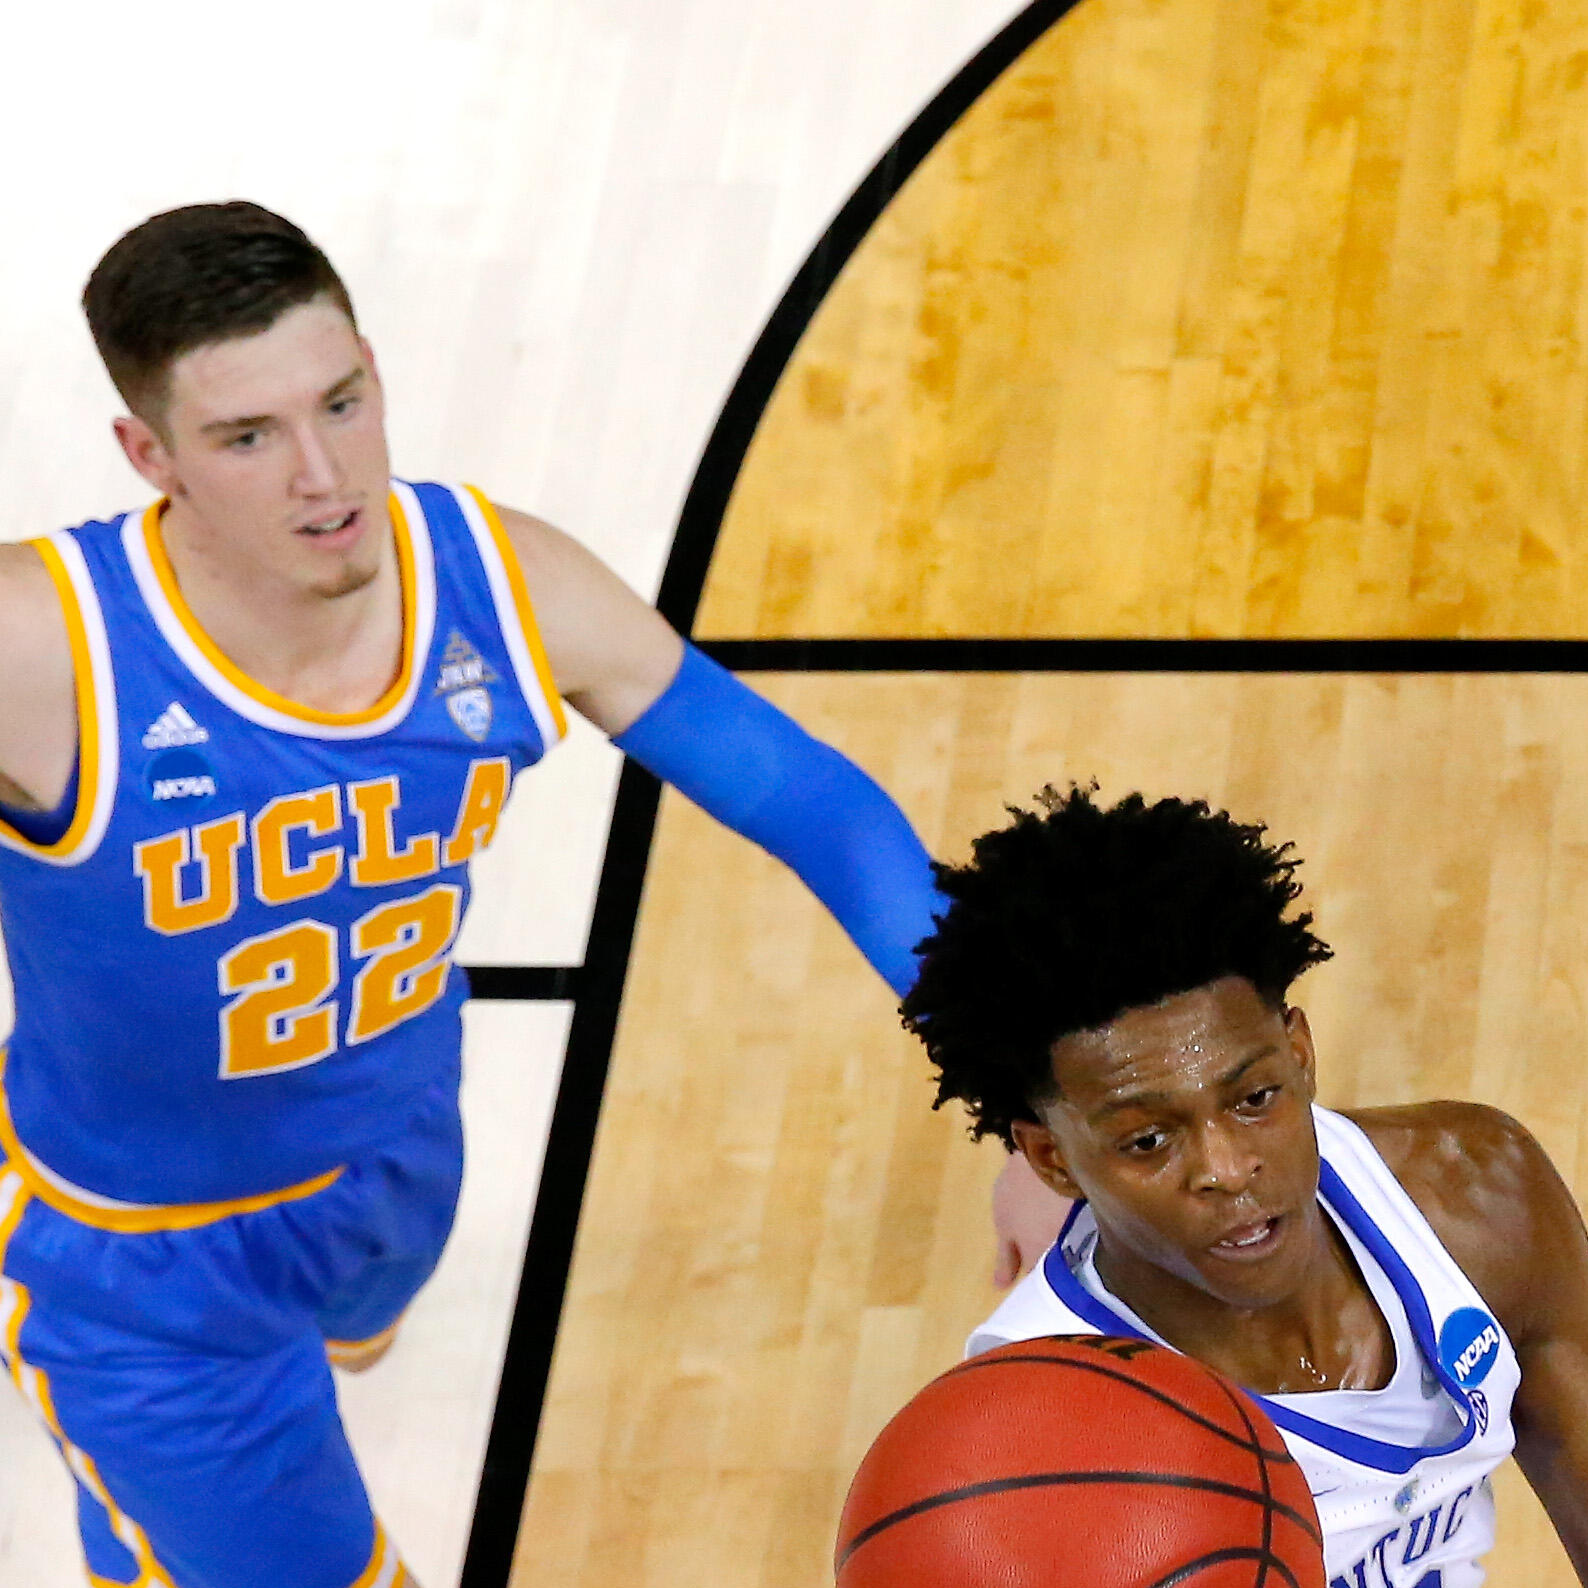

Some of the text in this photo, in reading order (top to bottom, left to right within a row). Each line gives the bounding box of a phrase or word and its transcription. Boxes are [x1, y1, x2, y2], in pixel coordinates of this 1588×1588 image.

[133, 755, 512, 937] UCLA
[217, 883, 463, 1080] 22
[1452, 1323, 1500, 1383] NCAA
